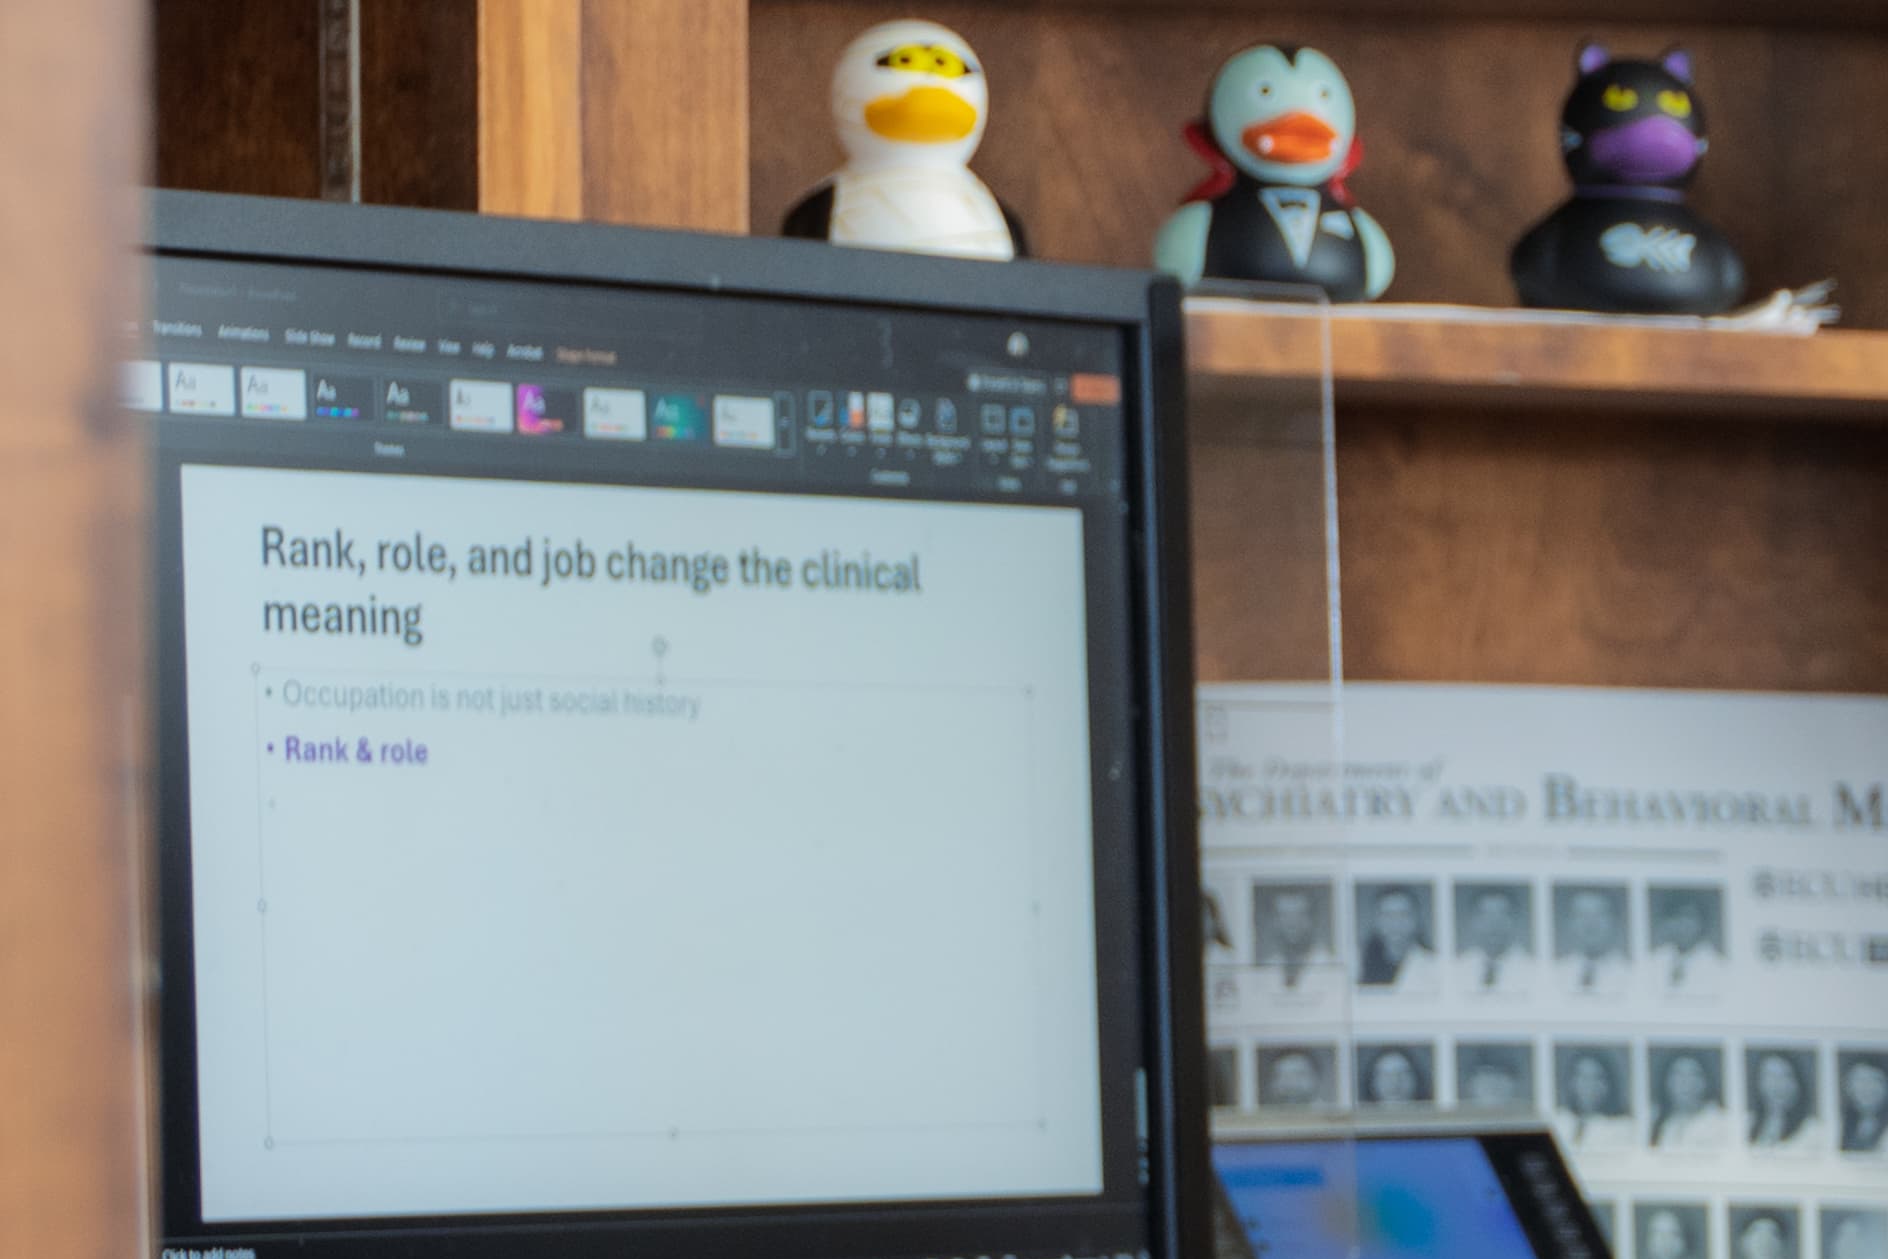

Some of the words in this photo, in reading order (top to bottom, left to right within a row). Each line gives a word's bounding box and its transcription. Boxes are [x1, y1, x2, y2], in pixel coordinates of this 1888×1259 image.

[261, 525, 367, 577] Rank,
[377, 530, 458, 582] role,
[467, 535, 532, 577] and
[540, 537, 597, 588] job
[606, 540, 729, 598] change
[738, 545, 793, 588] the
[802, 549, 922, 593] clinical
[263, 594, 424, 648] meaning
[282, 678, 424, 714] Occupation
[430, 683, 451, 711] is
[456, 686, 495, 712] not
[499, 686, 544, 718] just
[547, 687, 618, 715] social
[622, 689, 700, 725] history
[285, 735, 350, 764] Rank
[355, 736, 374, 764] &
[380, 738, 429, 766] role
[1438, 784, 1530, 821] AND
